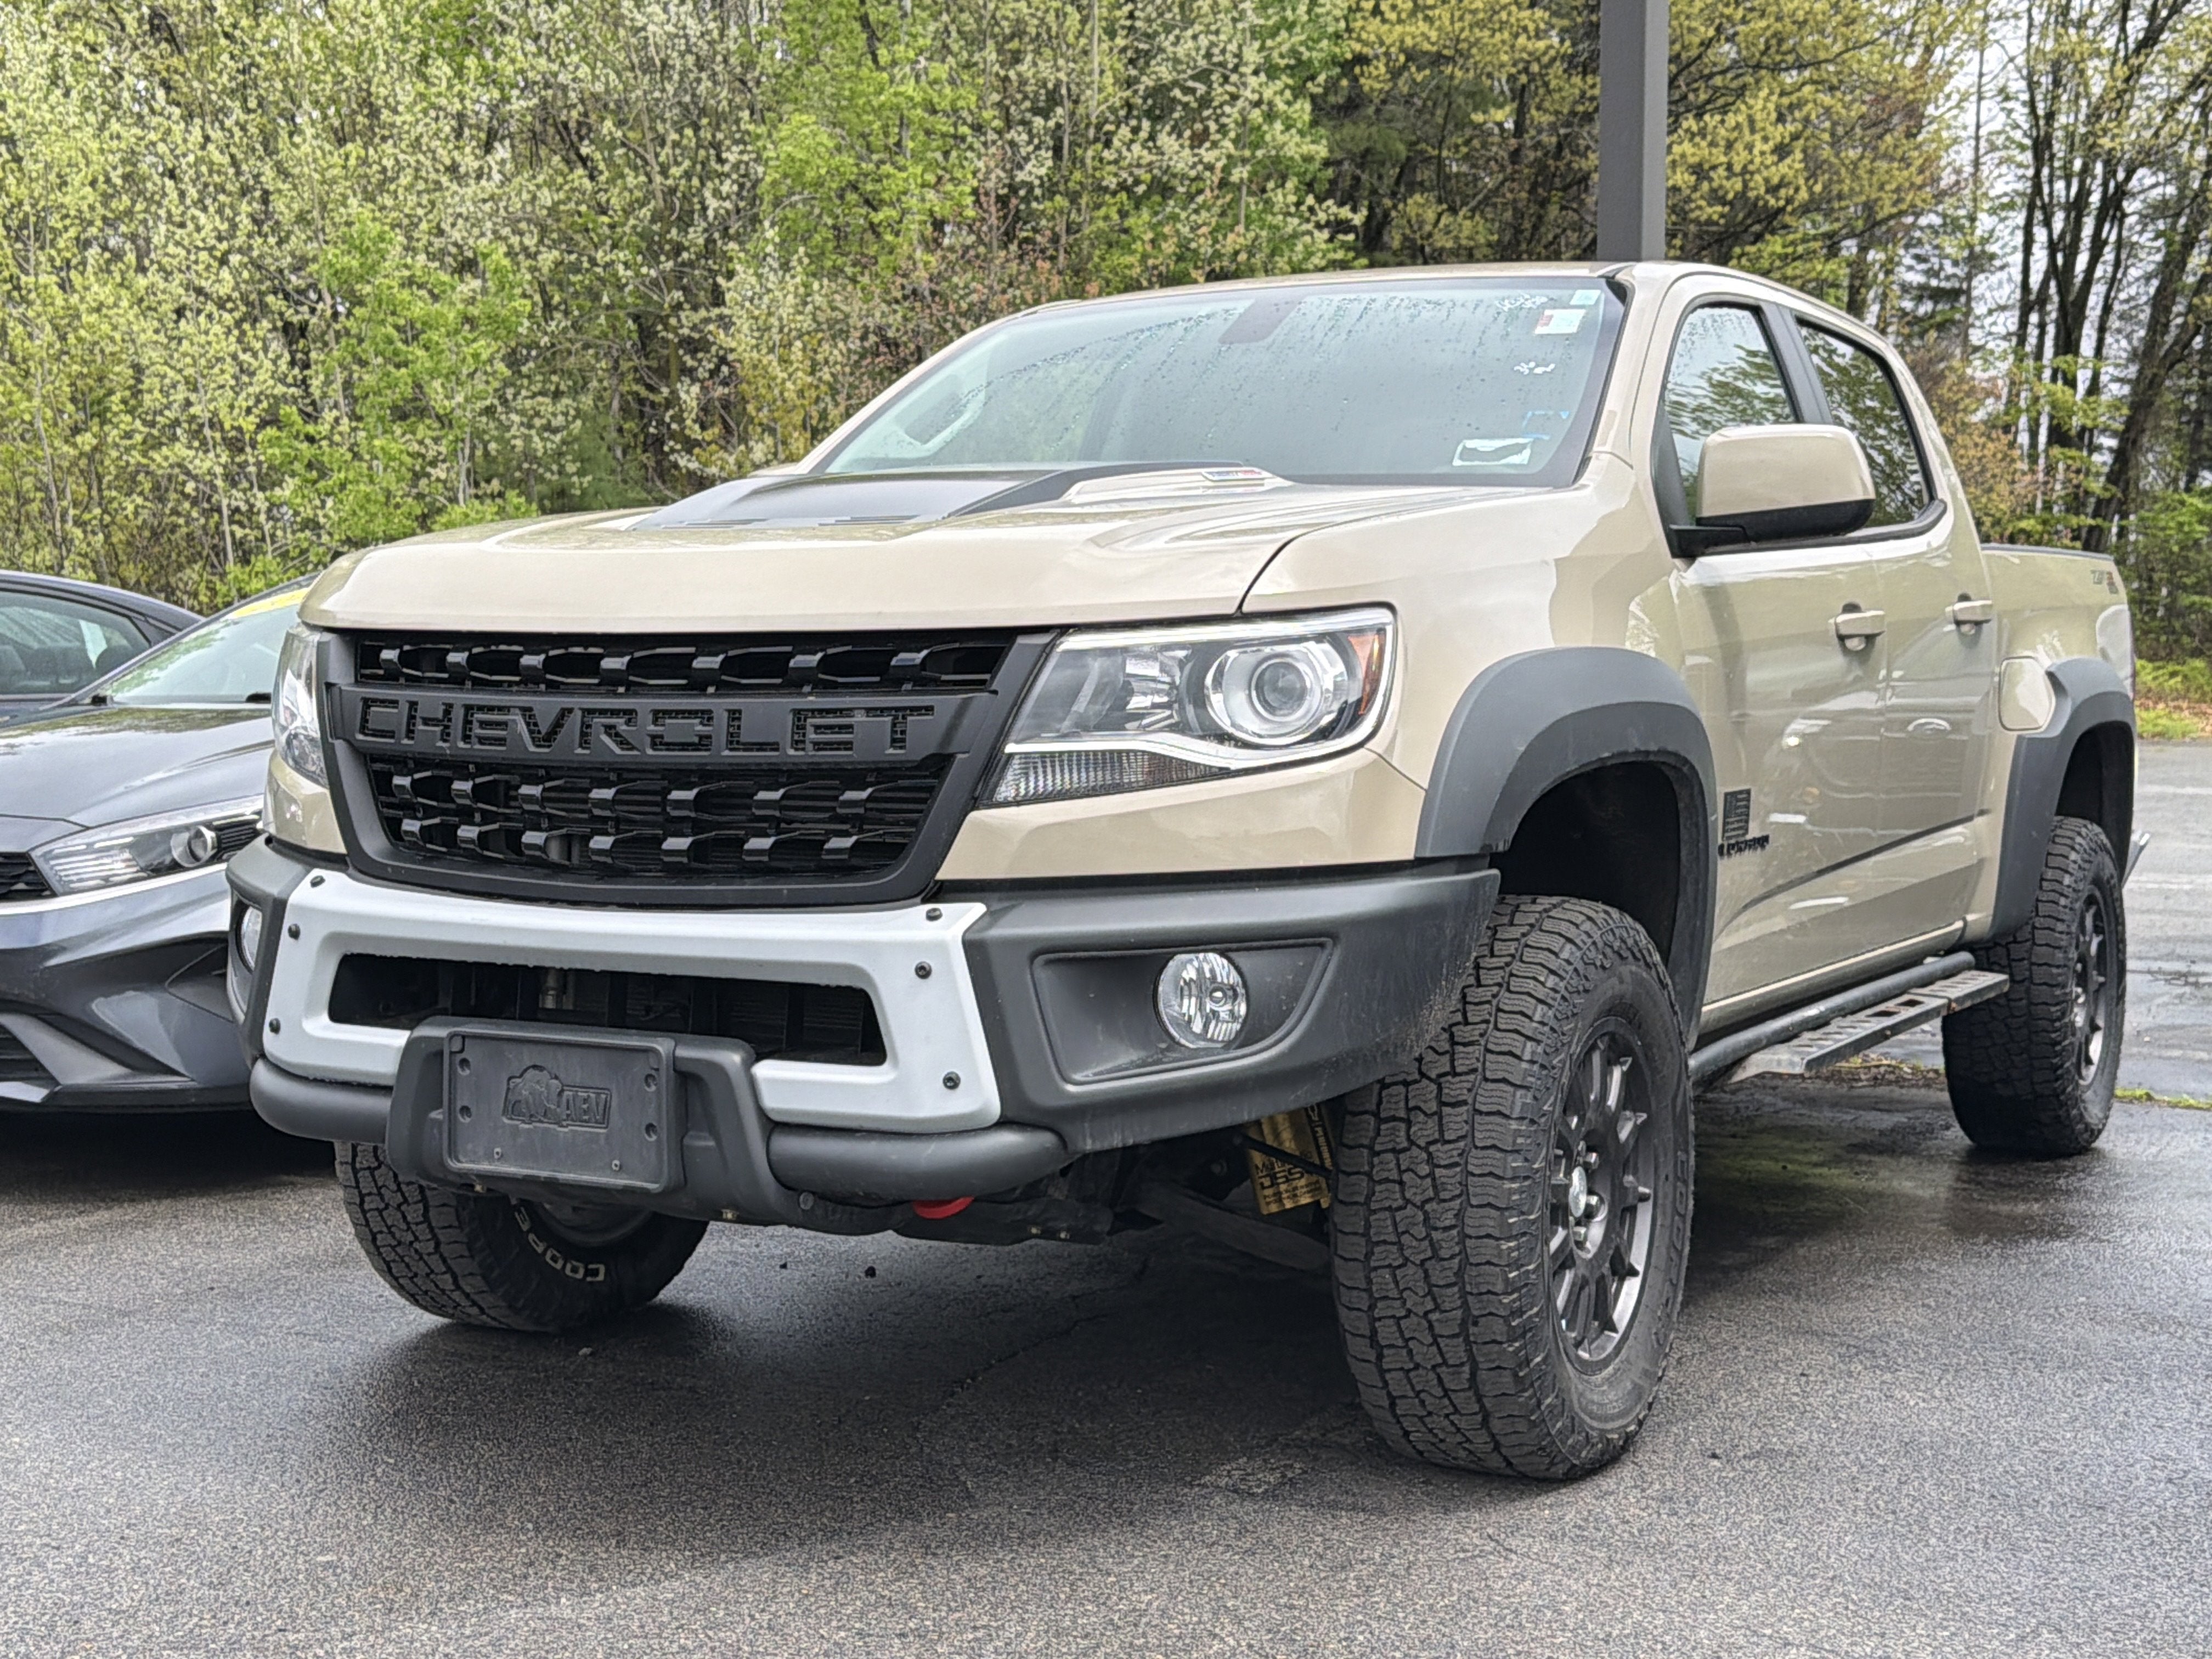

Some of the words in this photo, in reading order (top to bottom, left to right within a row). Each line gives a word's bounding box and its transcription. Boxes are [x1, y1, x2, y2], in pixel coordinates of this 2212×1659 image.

[356, 696, 935, 755] CHEVROLET
[560, 1091, 607, 1122] AEV
[514, 1206, 606, 1282] COOPE
